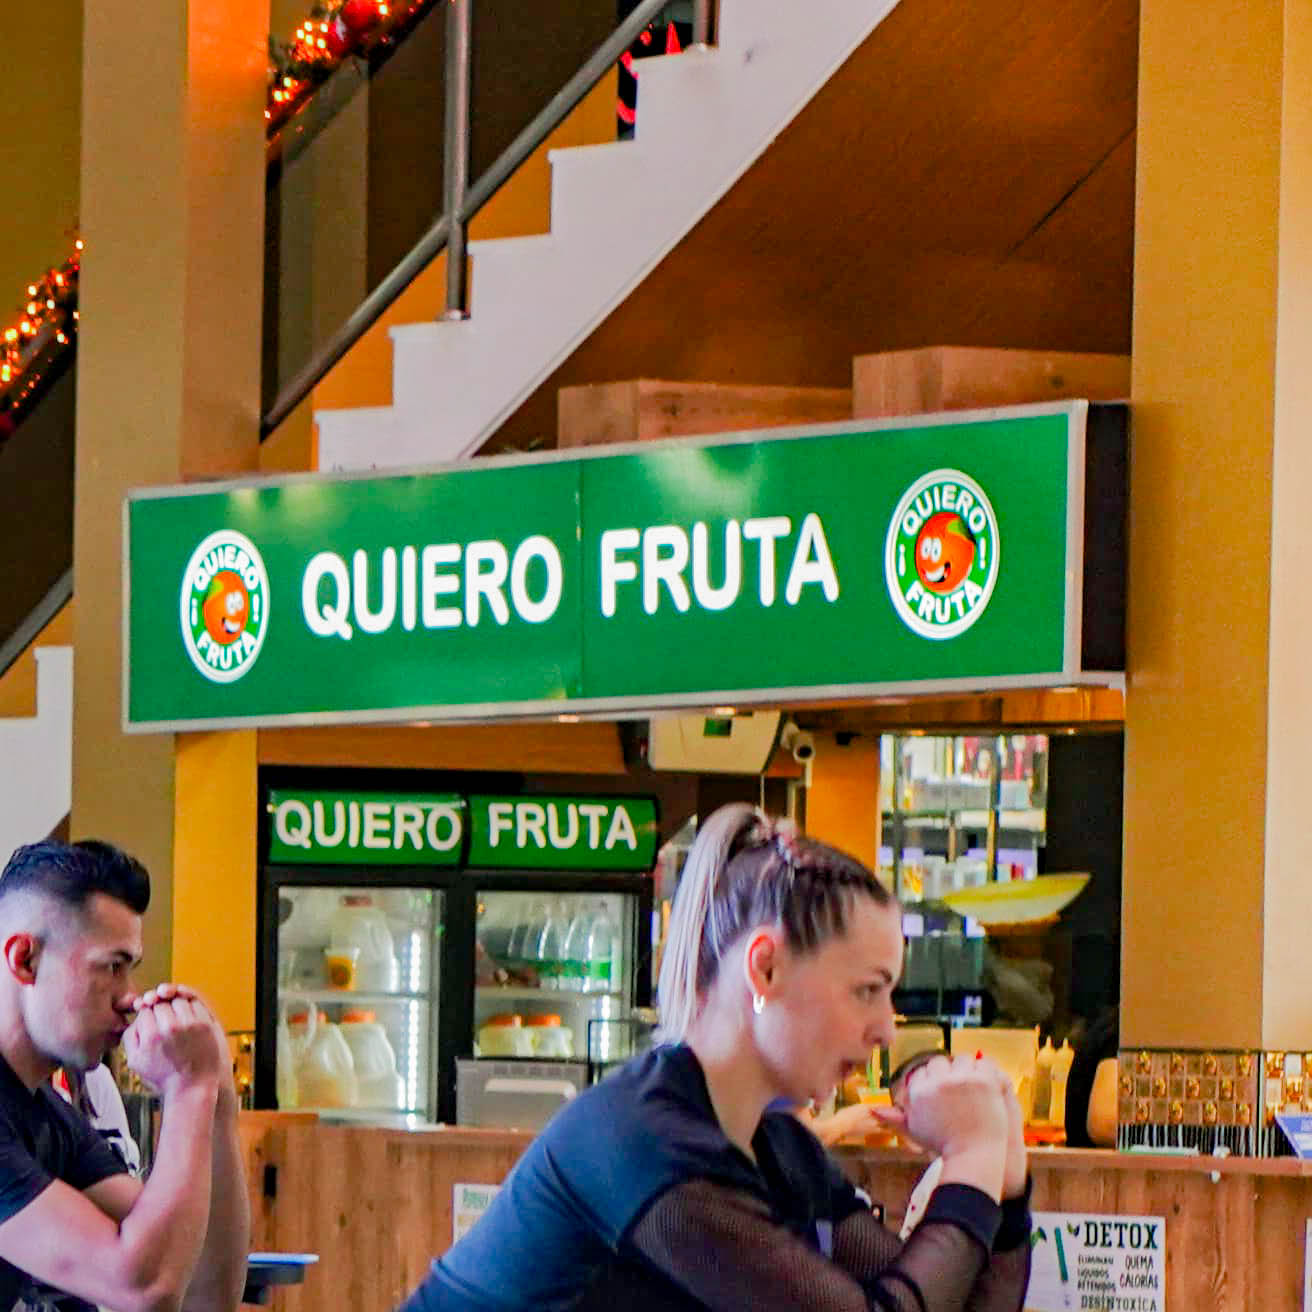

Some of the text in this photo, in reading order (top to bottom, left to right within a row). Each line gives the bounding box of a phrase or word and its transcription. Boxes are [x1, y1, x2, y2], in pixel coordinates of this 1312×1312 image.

[902, 484, 986, 536] QUIERO
[194, 543, 259, 591] QUIERO
[301, 512, 840, 641] QUIERO FRUTA
[906, 580, 984, 625] FRUTA
[196, 635, 258, 670] FRUTA
[275, 799, 637, 852] QUIERO FRUTA
[1084, 1221, 1158, 1250] DETOX
